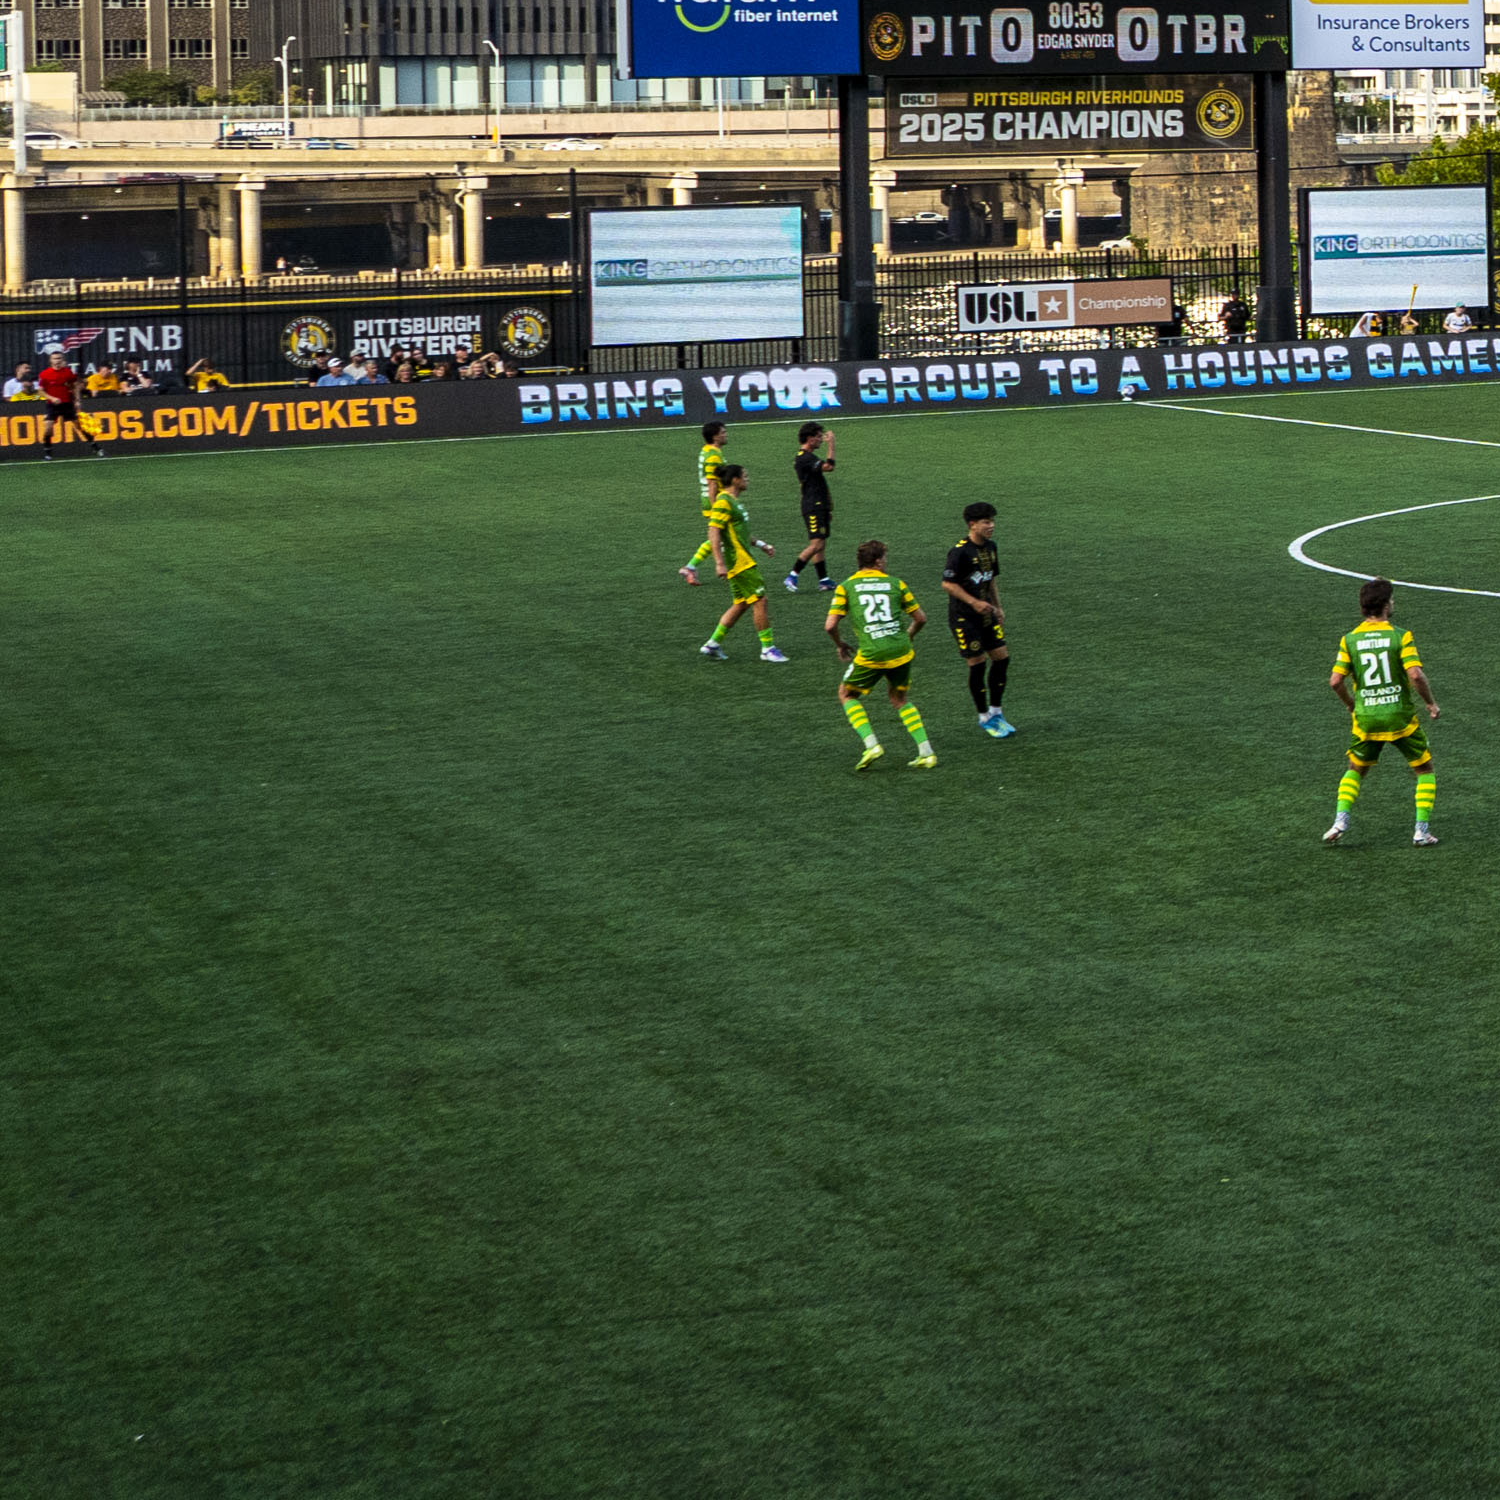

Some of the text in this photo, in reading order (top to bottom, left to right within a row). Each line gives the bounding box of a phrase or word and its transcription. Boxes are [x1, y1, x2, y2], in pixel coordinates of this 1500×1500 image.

[734, 9, 839, 22] fiber internet
[1048, 2, 1104, 29] 80:53
[1317, 14, 1470, 30] Insurance Brokers
[911, 15, 983, 57] PIT
[1166, 14, 1248, 55] TBR
[1037, 33, 1115, 50] EDGAR SNYDER
[1351, 35, 1470, 52] & Consultants
[973, 92, 1073, 107] PITTSBURGH
[1075, 90, 1184, 105] RIVERHOUNDS
[899, 109, 1184, 143] 2025 CHAMPIONS
[1314, 233, 1486, 253] KING ORTHODONTICS
[596, 256, 800, 279] KING ORTHODONTICS
[963, 291, 1167, 325] USL Championship
[353, 314, 481, 338] PITTSBURGH
[518, 377, 686, 424] BRING
[858, 360, 1022, 404] GROUP
[1039, 357, 1099, 396] TO
[1119, 355, 1151, 392] A
[1163, 345, 1351, 390] HOUNDS
[858, 593, 893, 623] 23
[1360, 651, 1393, 687] 21
